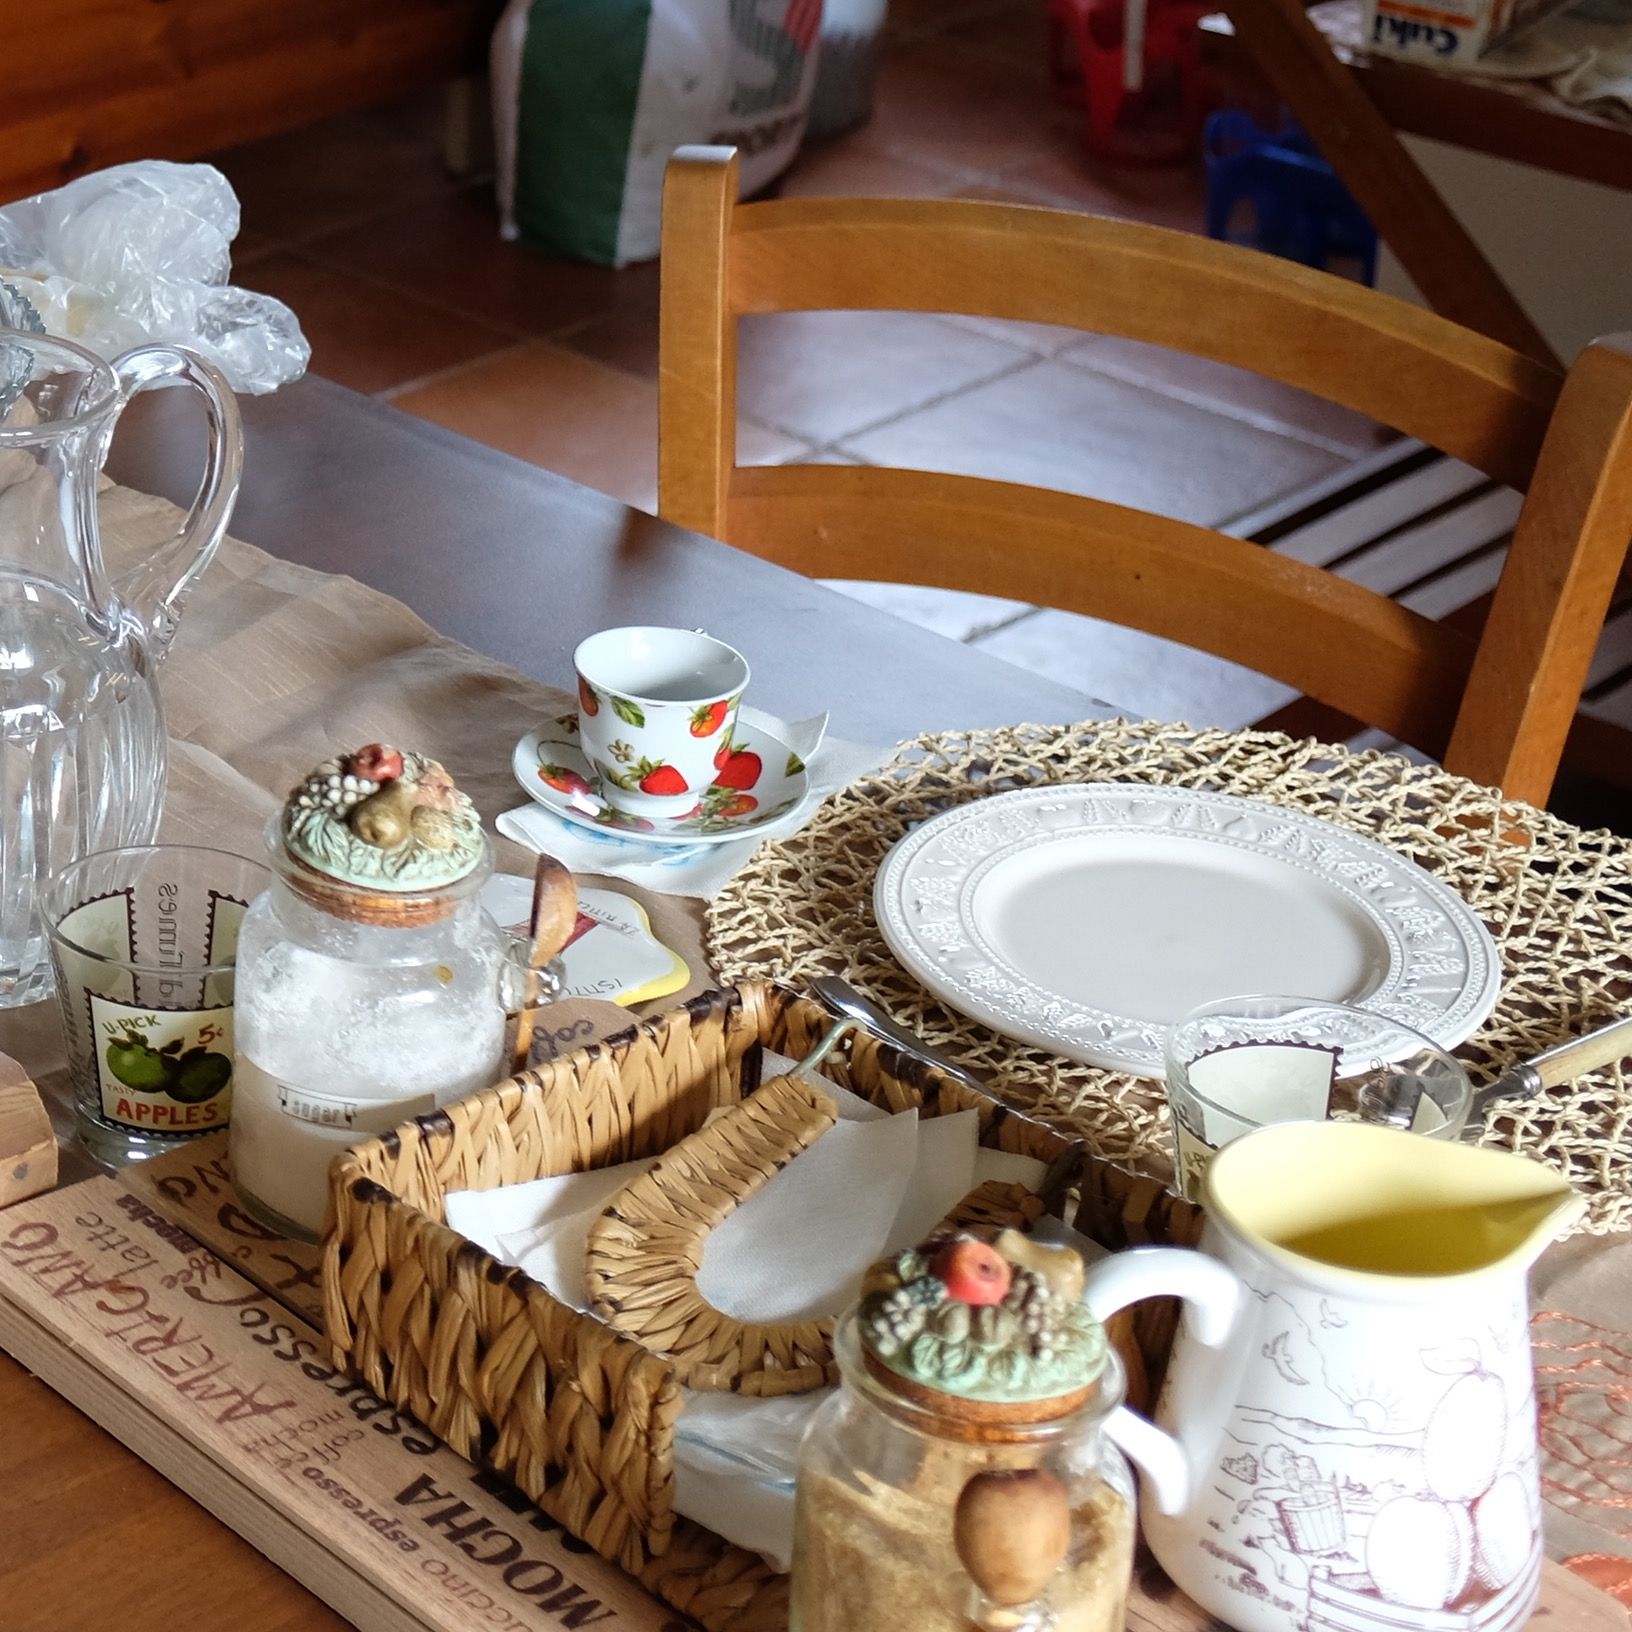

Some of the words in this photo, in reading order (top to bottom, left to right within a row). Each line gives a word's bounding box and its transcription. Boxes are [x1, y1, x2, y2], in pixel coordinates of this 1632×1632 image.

[1375, 13, 1459, 56] Cuki
[115, 1097, 219, 1126] APPLES
[75, 1211, 158, 1278] latte
[0, 1221, 297, 1425] AMERICANO
[239, 1307, 444, 1456] espresso
[302, 1466, 421, 1554] espresso
[393, 1472, 618, 1631] MOCHA
